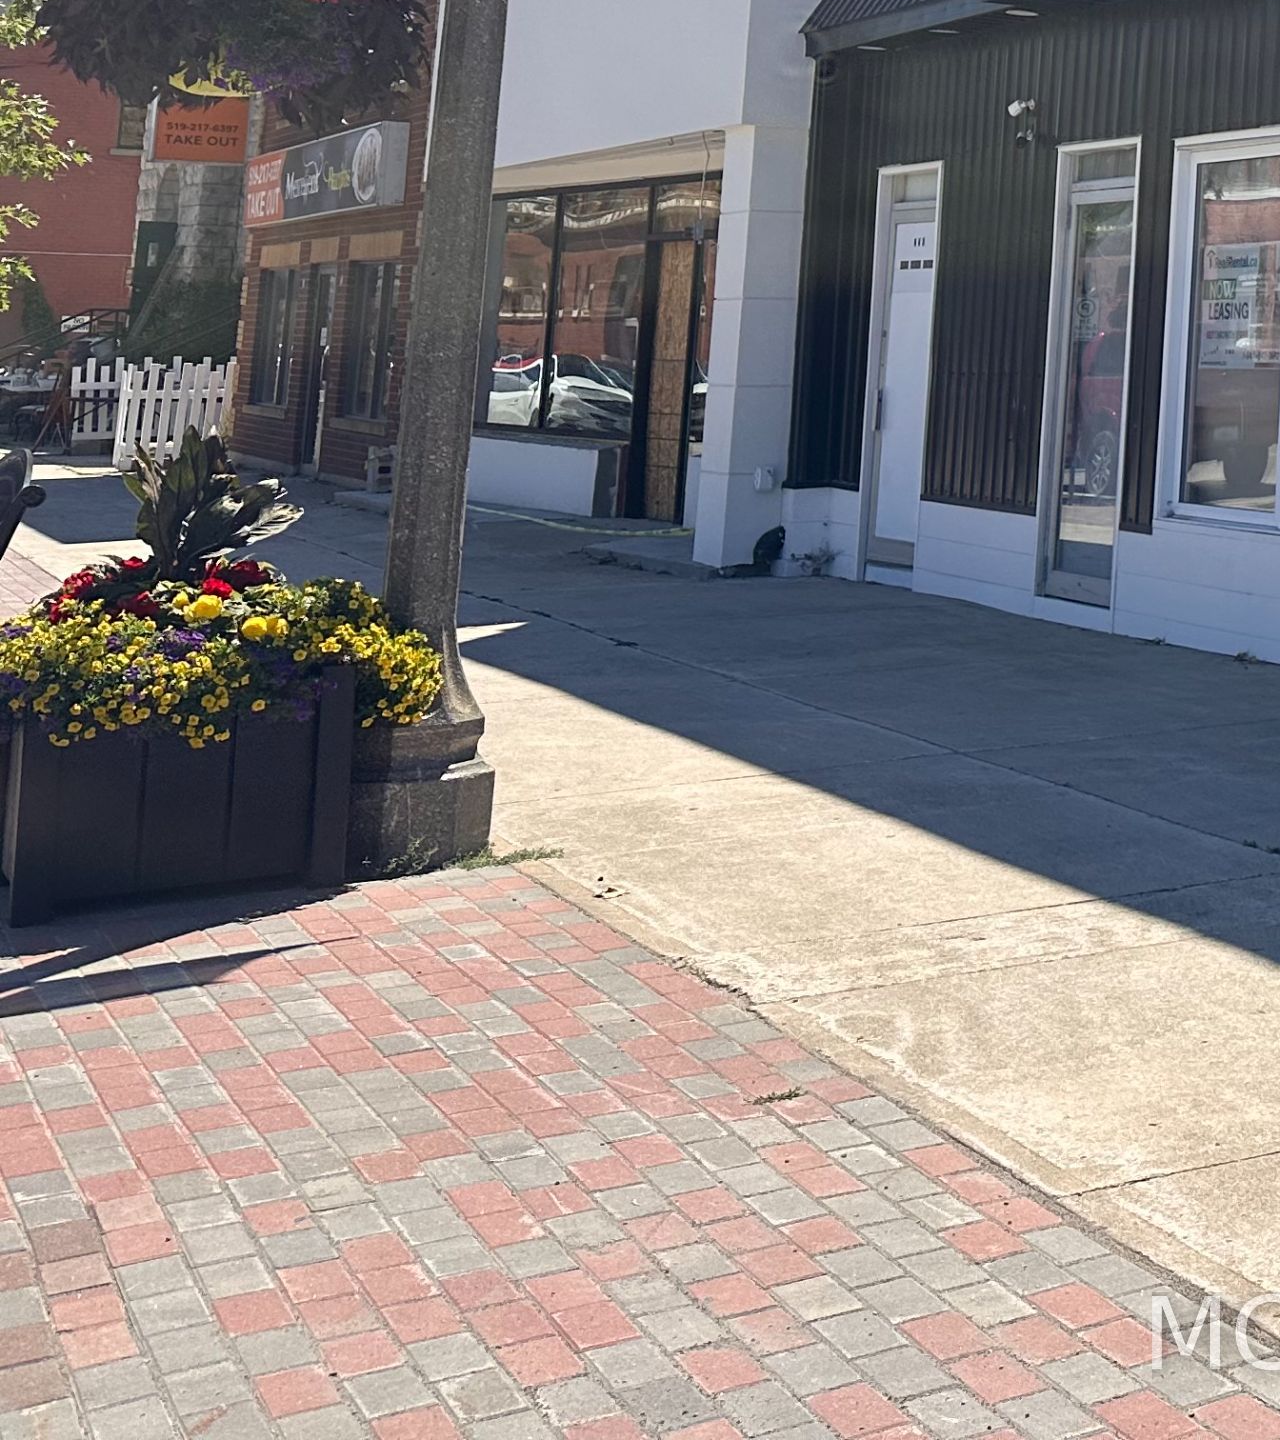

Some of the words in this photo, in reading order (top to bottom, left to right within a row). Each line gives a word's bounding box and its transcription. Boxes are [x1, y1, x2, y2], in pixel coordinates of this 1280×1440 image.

[165, 134, 202, 146] TAKE
[207, 135, 240, 148] OUT
[1209, 280, 1236, 299] NOW
[1208, 302, 1250, 320] LEASING
